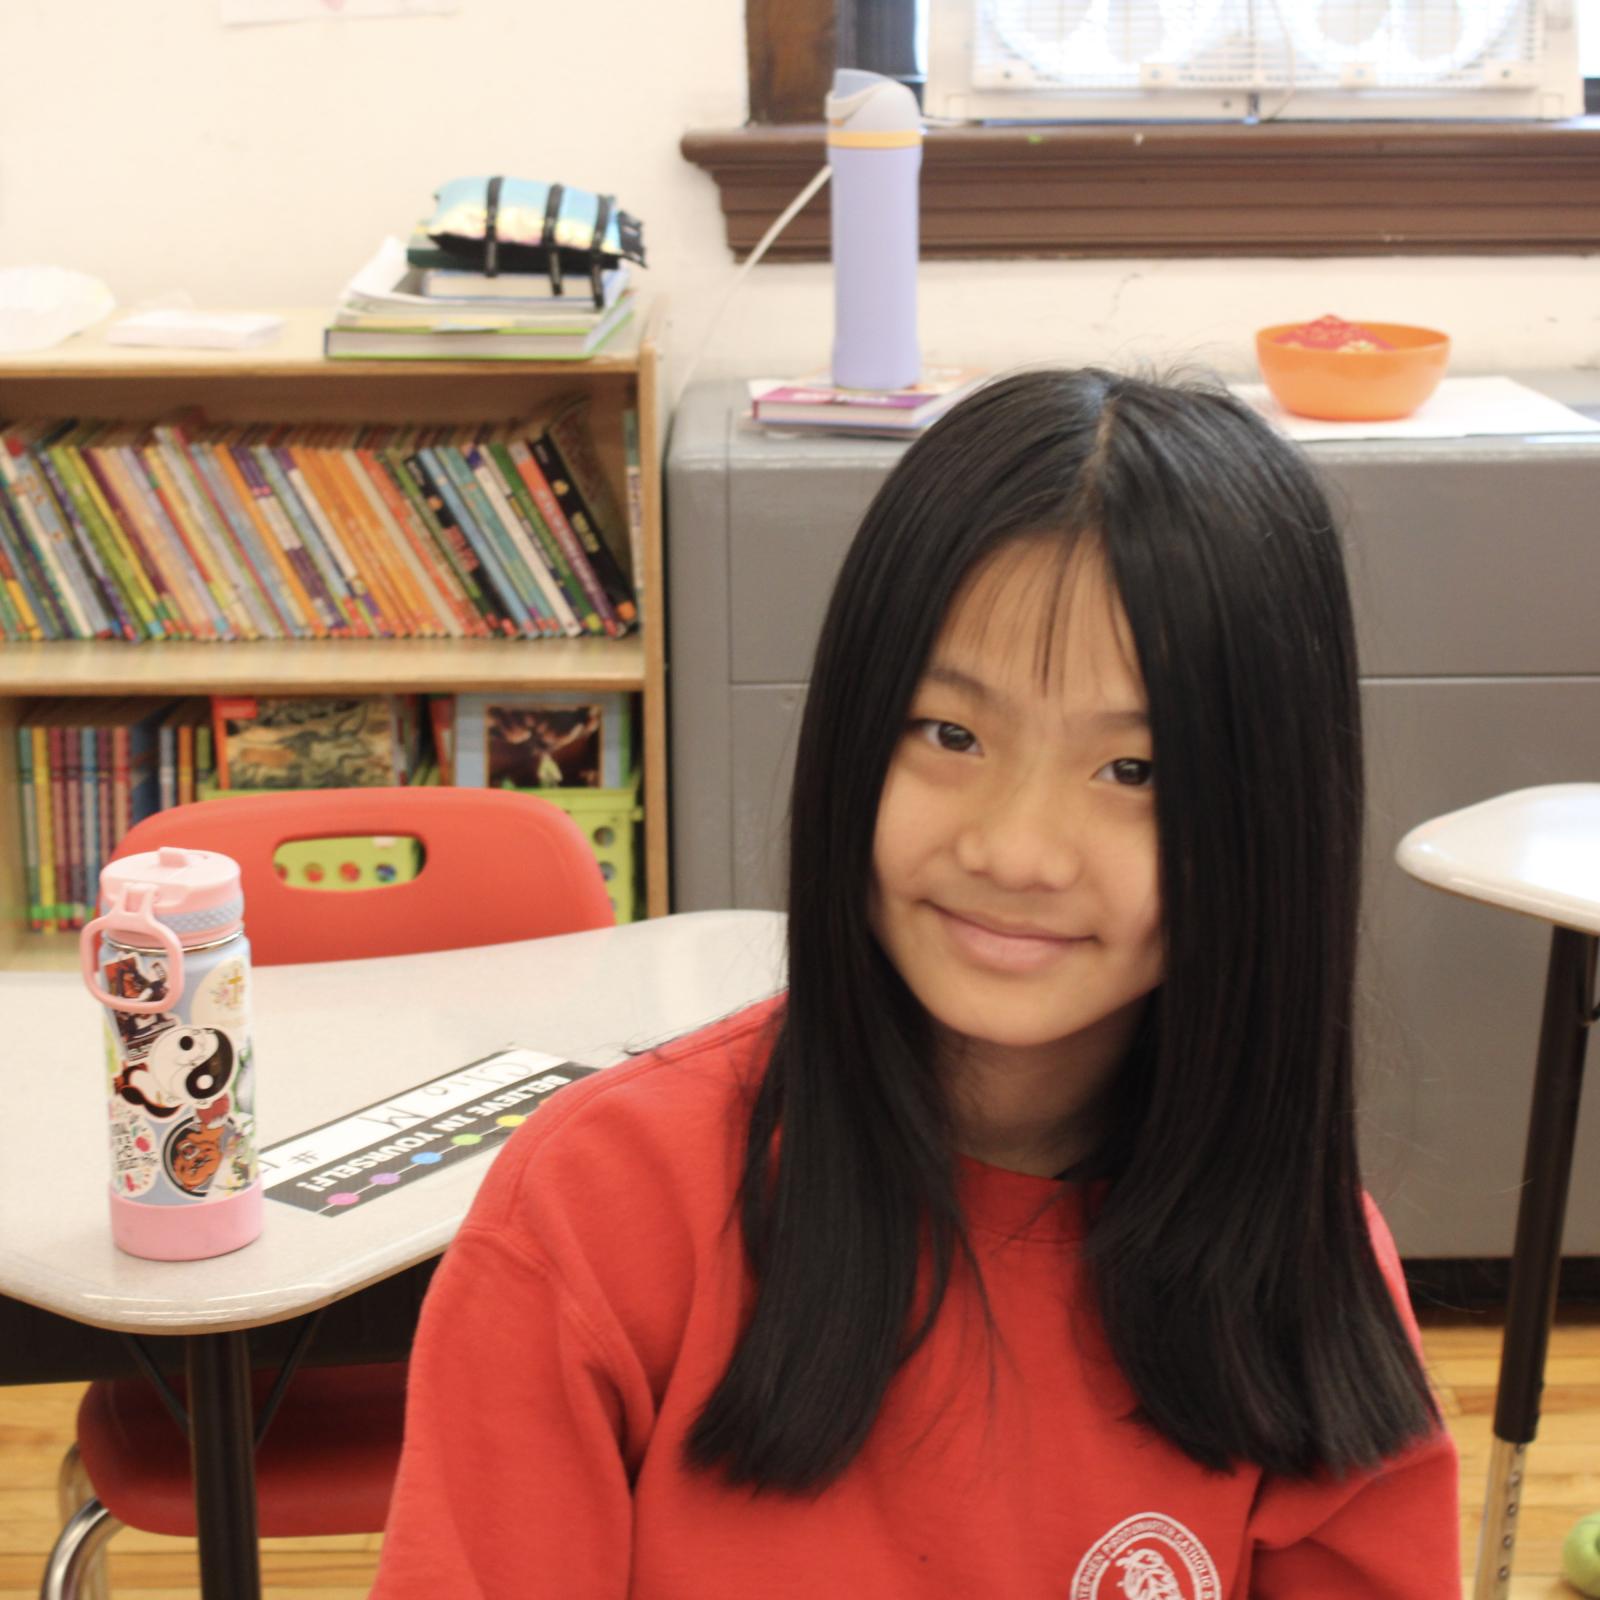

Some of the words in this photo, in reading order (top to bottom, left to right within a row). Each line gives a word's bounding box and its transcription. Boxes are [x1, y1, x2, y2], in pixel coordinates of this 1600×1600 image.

[464, 1074, 572, 1117] BELIEVE
[357, 1105, 431, 1128] M
[430, 1114, 479, 1132] IN
[295, 1131, 445, 1192] YOURSELF!
